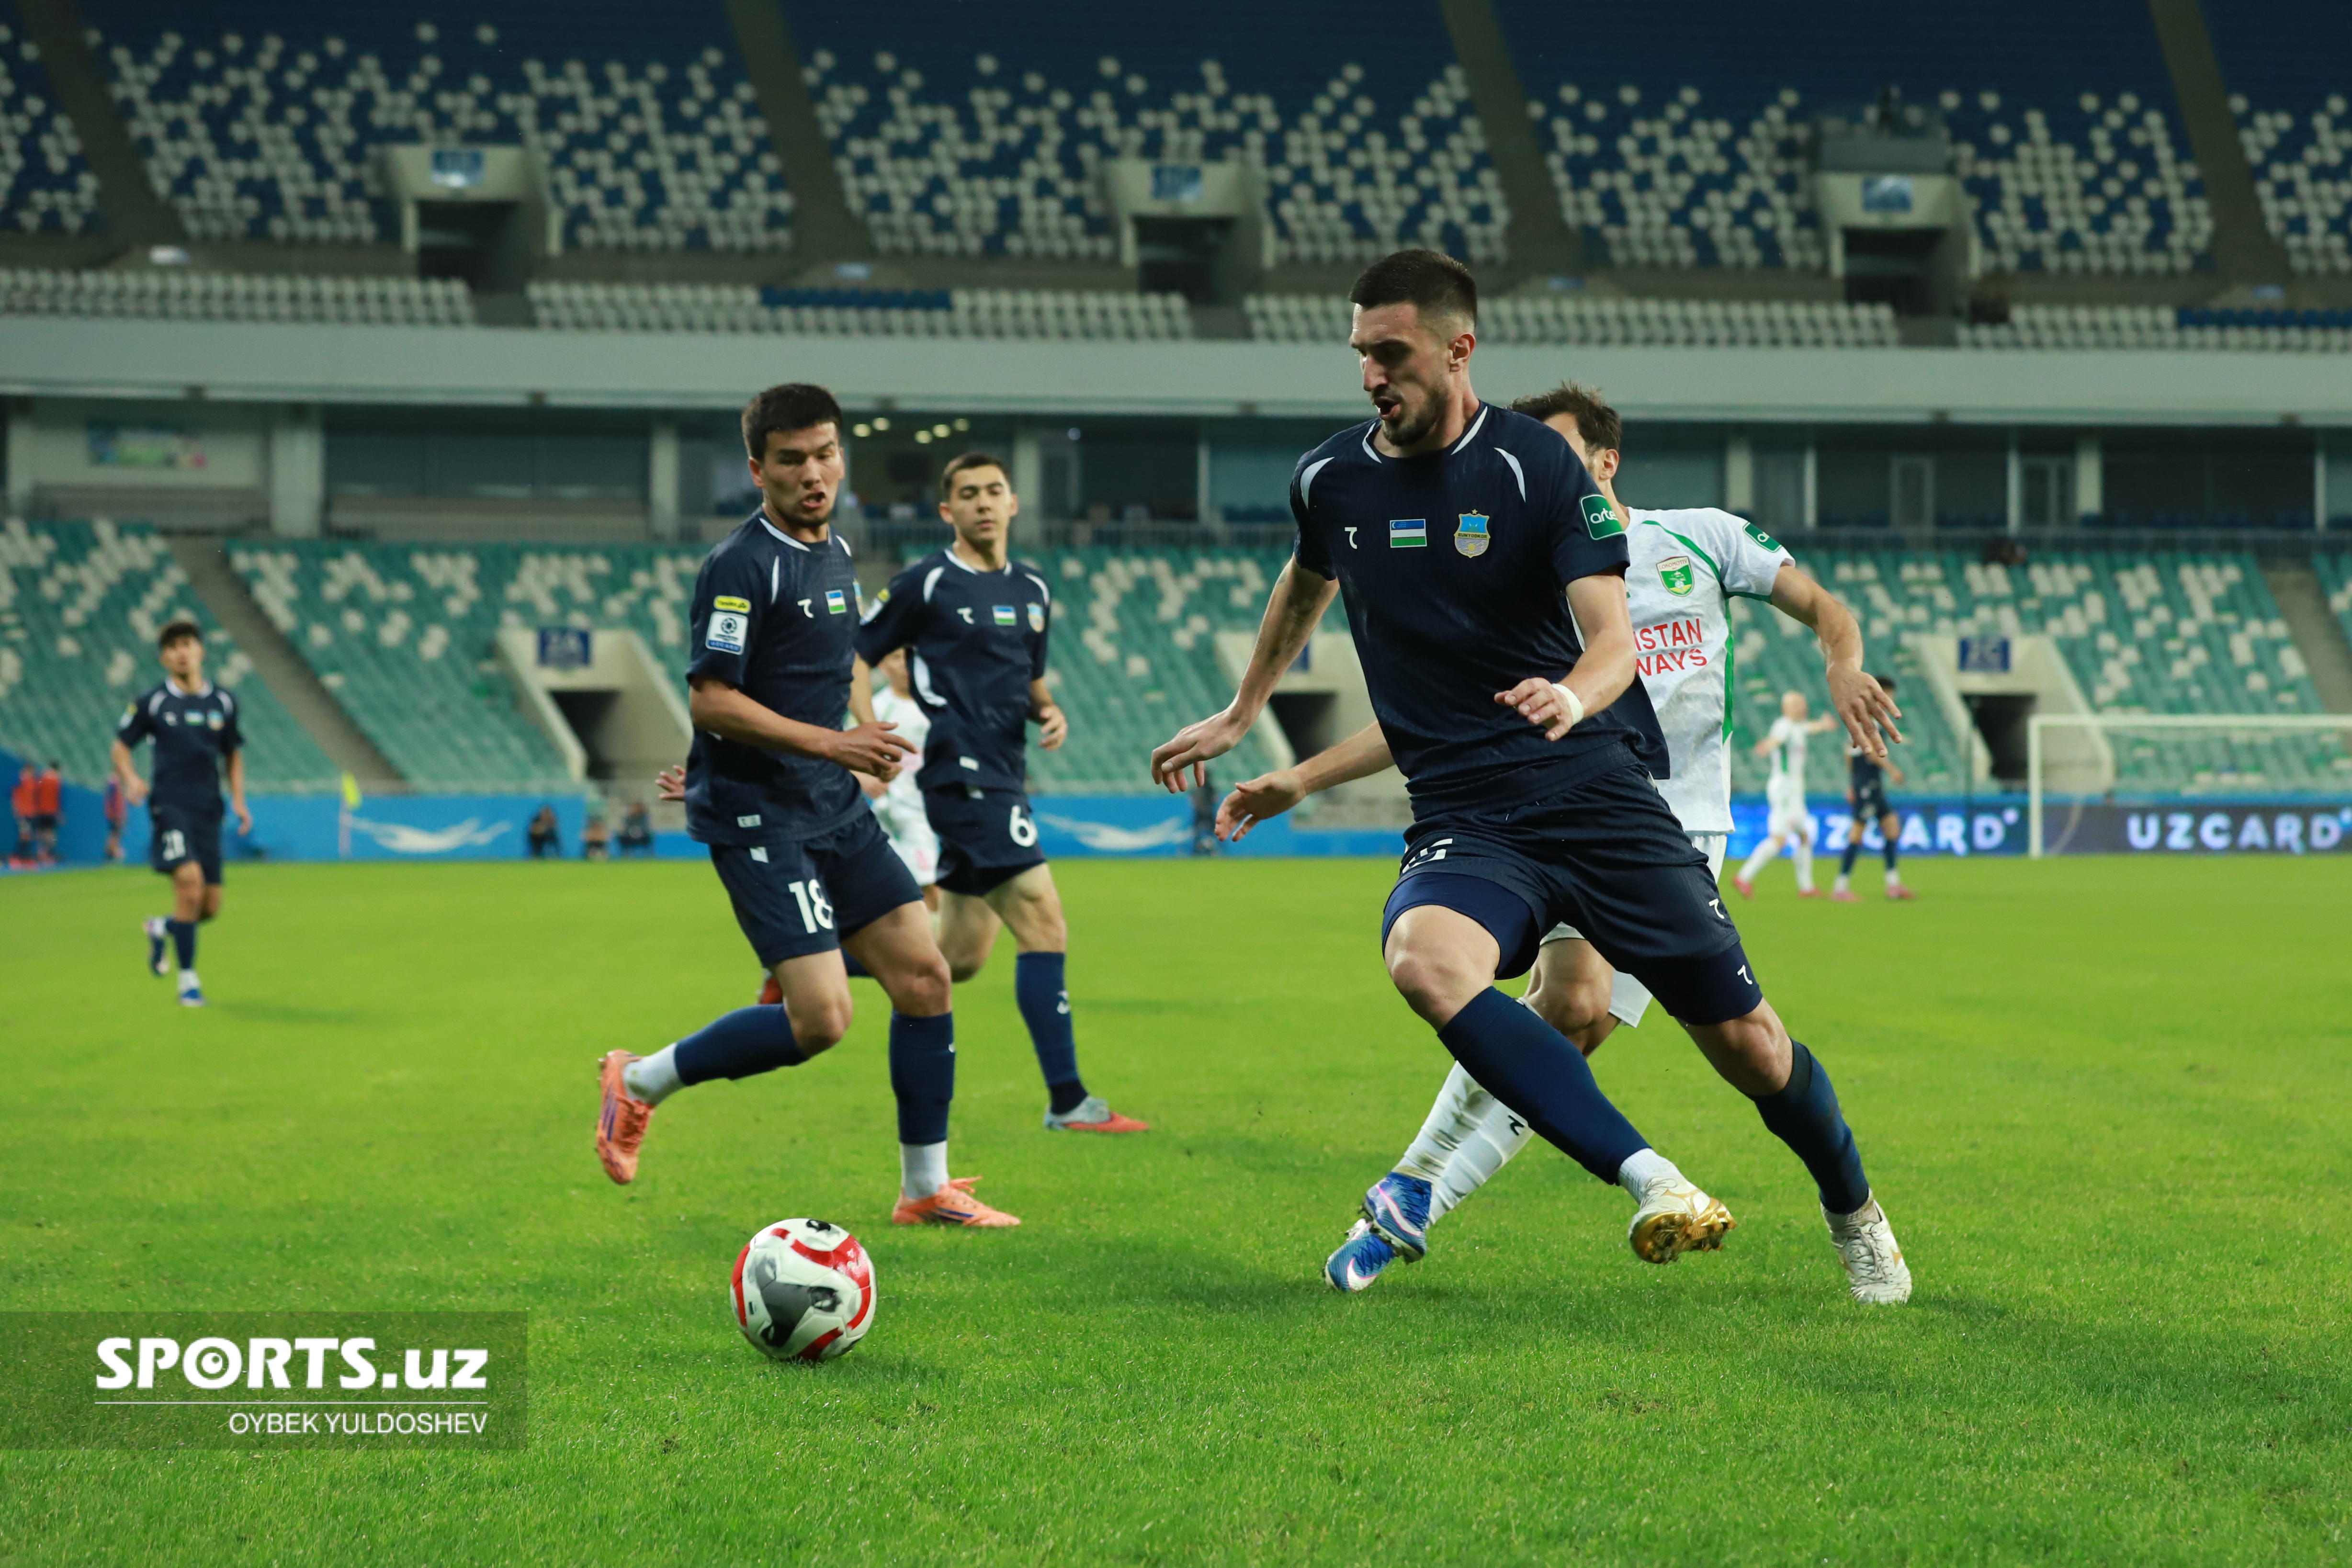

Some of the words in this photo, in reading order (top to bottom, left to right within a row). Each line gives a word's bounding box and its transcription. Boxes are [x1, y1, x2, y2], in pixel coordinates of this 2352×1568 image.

[1659, 559, 1687, 570] LOKOMOTIV
[1009, 805, 1038, 847] 6
[2127, 813, 2341, 855] UZCARD
[788, 879, 834, 934] 18
